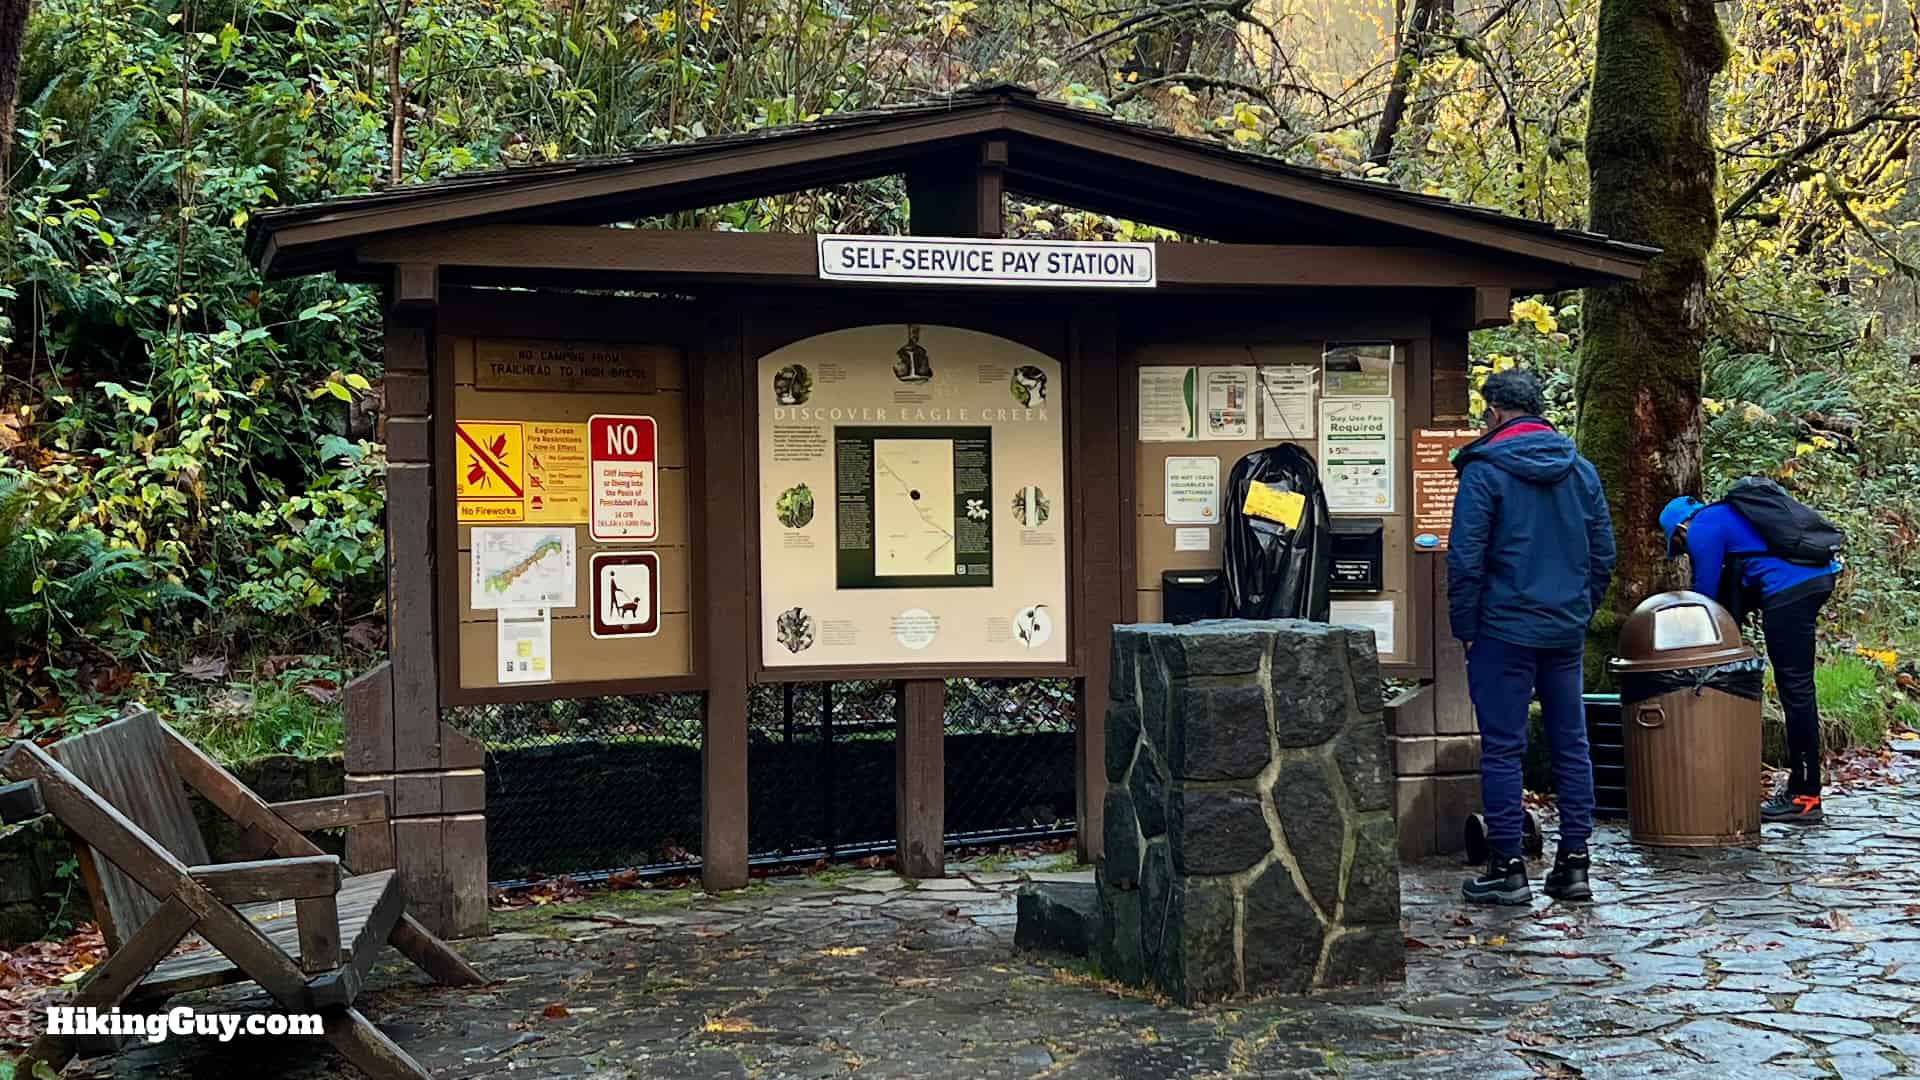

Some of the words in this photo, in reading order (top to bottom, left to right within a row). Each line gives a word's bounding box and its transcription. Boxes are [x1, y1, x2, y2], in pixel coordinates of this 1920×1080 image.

[841, 246, 994, 273] SELF-SERVICE
[1002, 250, 1039, 274] PAY
[1047, 251, 1135, 276] STATION
[518, 350, 532, 361] NO
[541, 351, 585, 362] CAMPING
[489, 362, 551, 377] TRAILHEAD
[560, 366, 574, 377] TO
[580, 367, 605, 378] HIGH
[774, 407, 887, 421] DISCOVER
[901, 407, 969, 421] EAGLE
[982, 407, 1049, 422] CREEK
[1330, 415, 1346, 424] Day
[1349, 414, 1365, 422] Use
[1368, 414, 1384, 422] Fee
[534, 426, 553, 435] Eagle
[555, 427, 575, 435] Creek
[1330, 422, 1383, 433] Required
[528, 435, 541, 443] Fire
[542, 436, 582, 444] Restrictions
[606, 424, 638, 455] NO
[604, 469, 617, 477] Cliff
[606, 489, 616, 497] the
[635, 489, 642, 497] of
[461, 506, 475, 516] No
[475, 506, 517, 516] Fireworks
